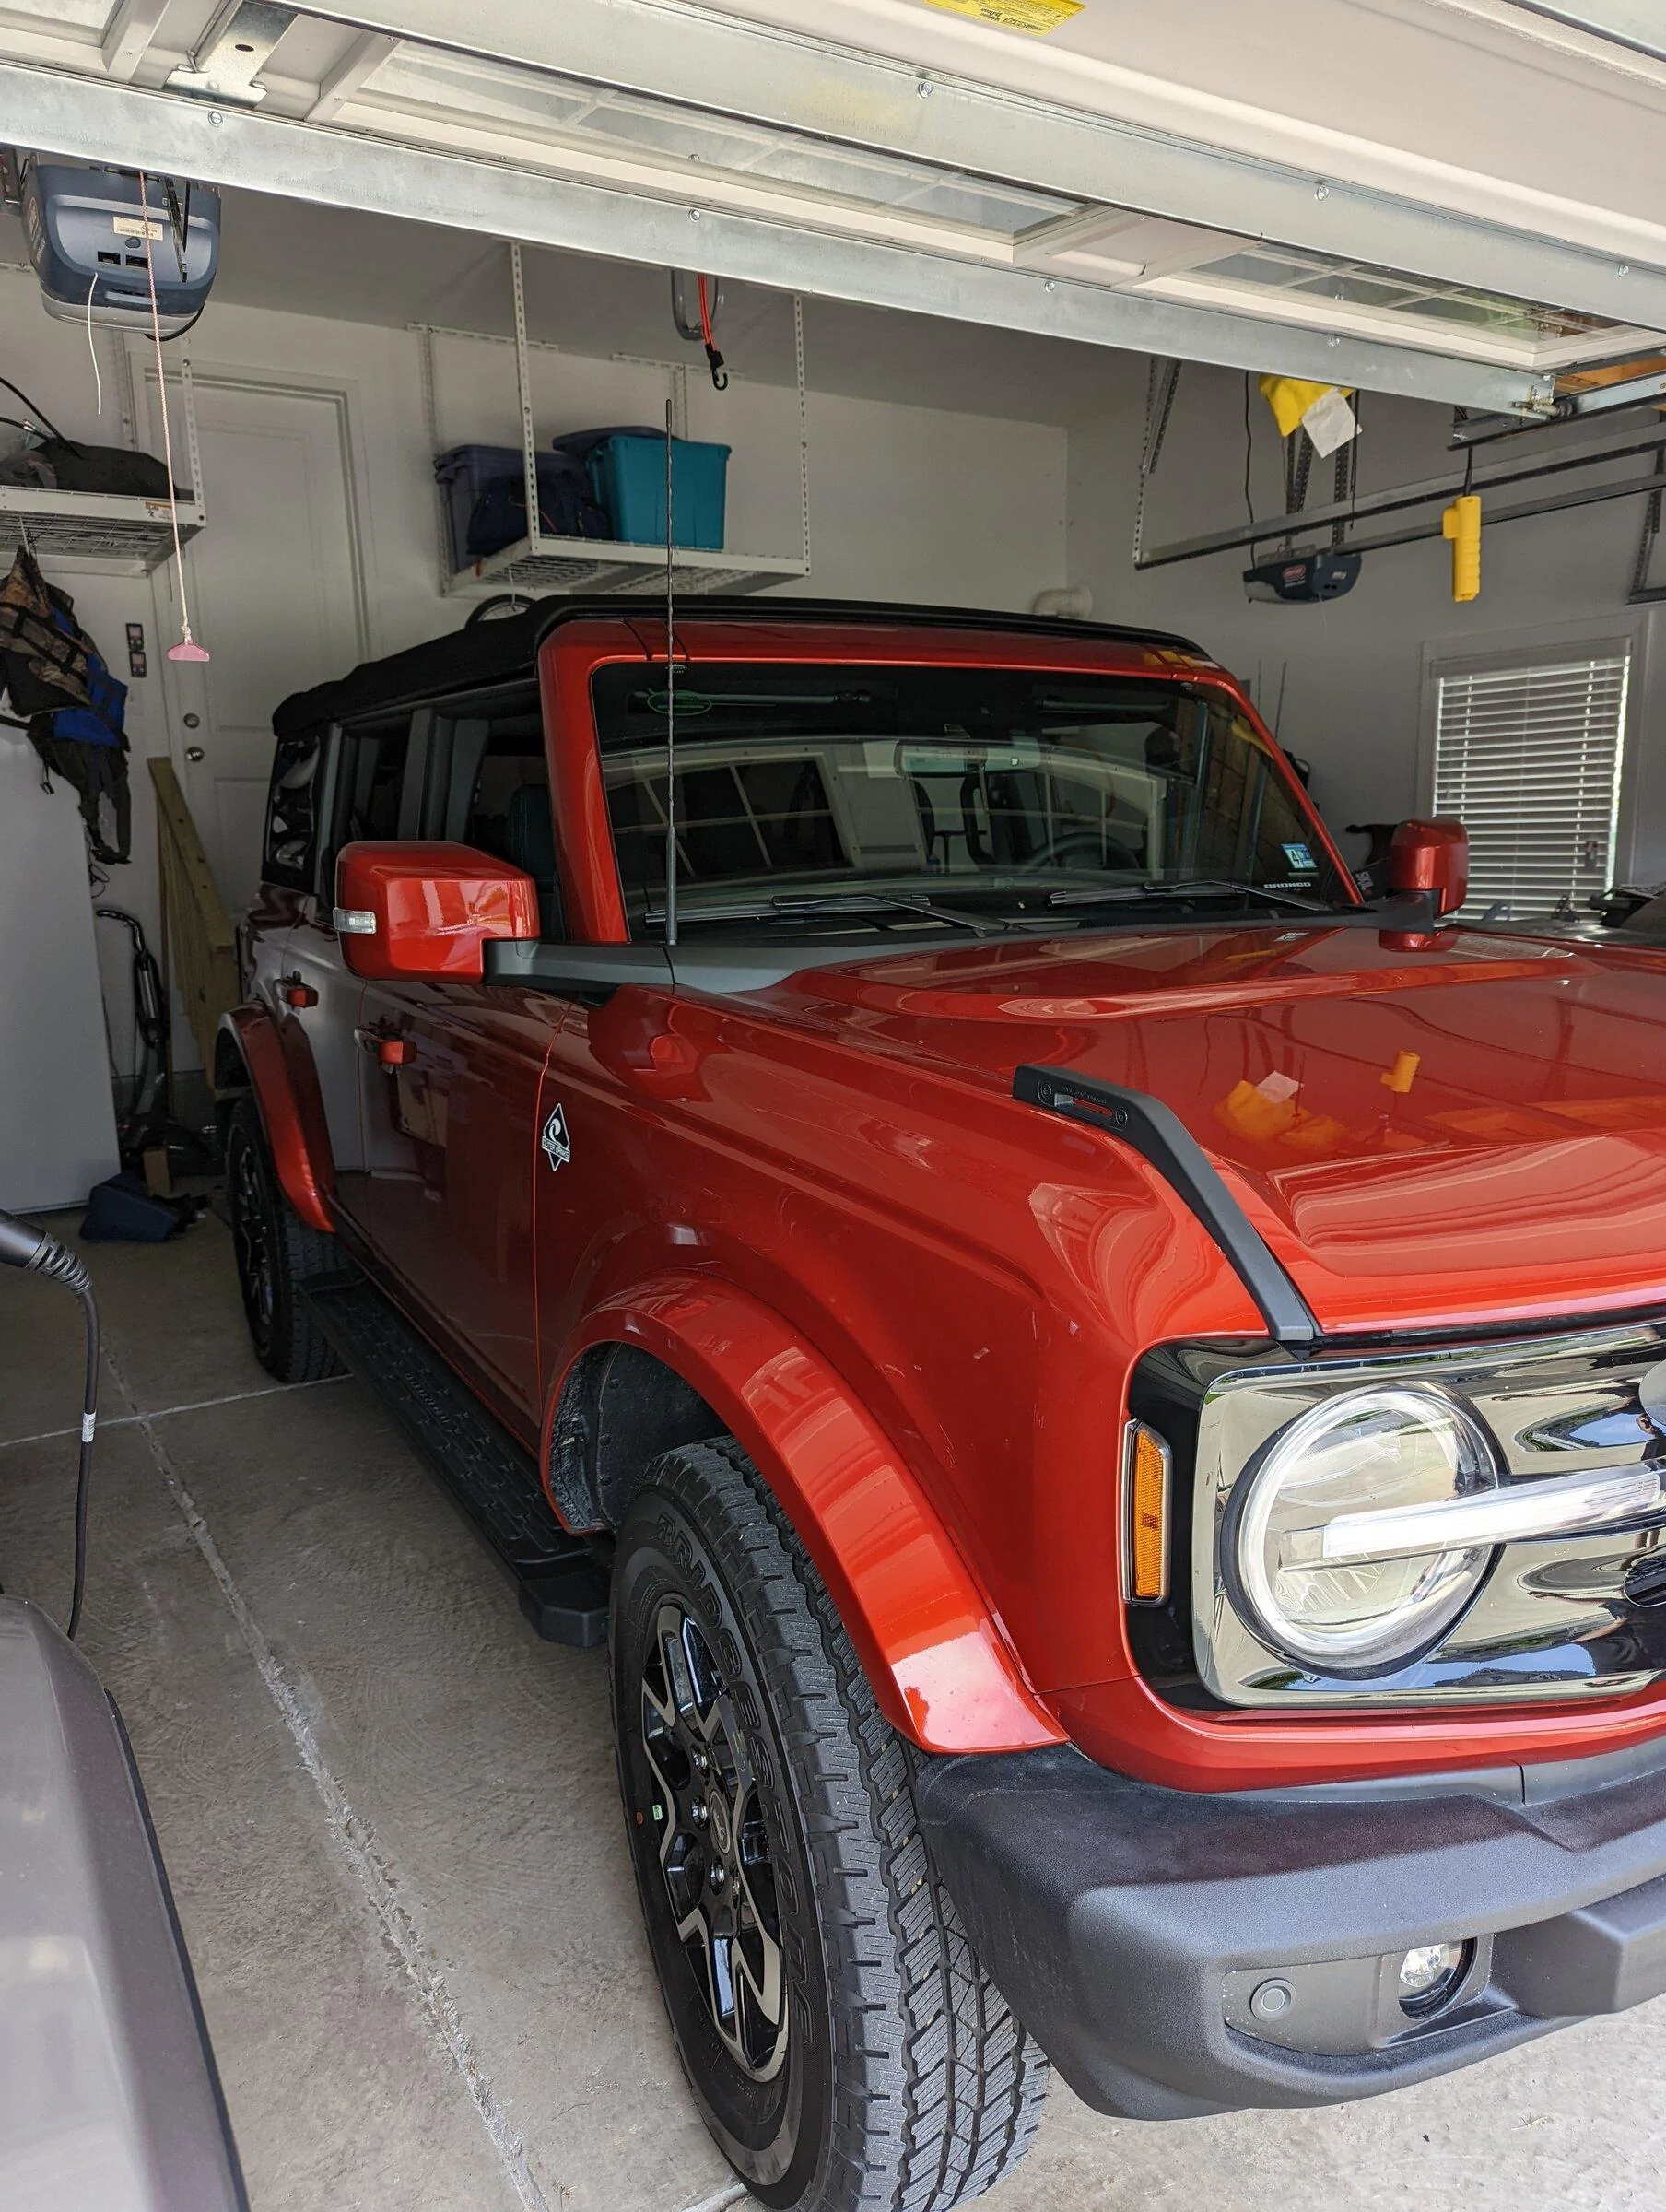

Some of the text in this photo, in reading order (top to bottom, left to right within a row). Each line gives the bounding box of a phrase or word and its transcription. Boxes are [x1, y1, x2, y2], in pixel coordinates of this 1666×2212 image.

[1291, 850, 1300, 865] 4
[1263, 881, 1312, 889] BRONCO
[1356, 871, 1374, 891] SKIL
[657, 1512, 815, 2044] BRIDGESTONE
